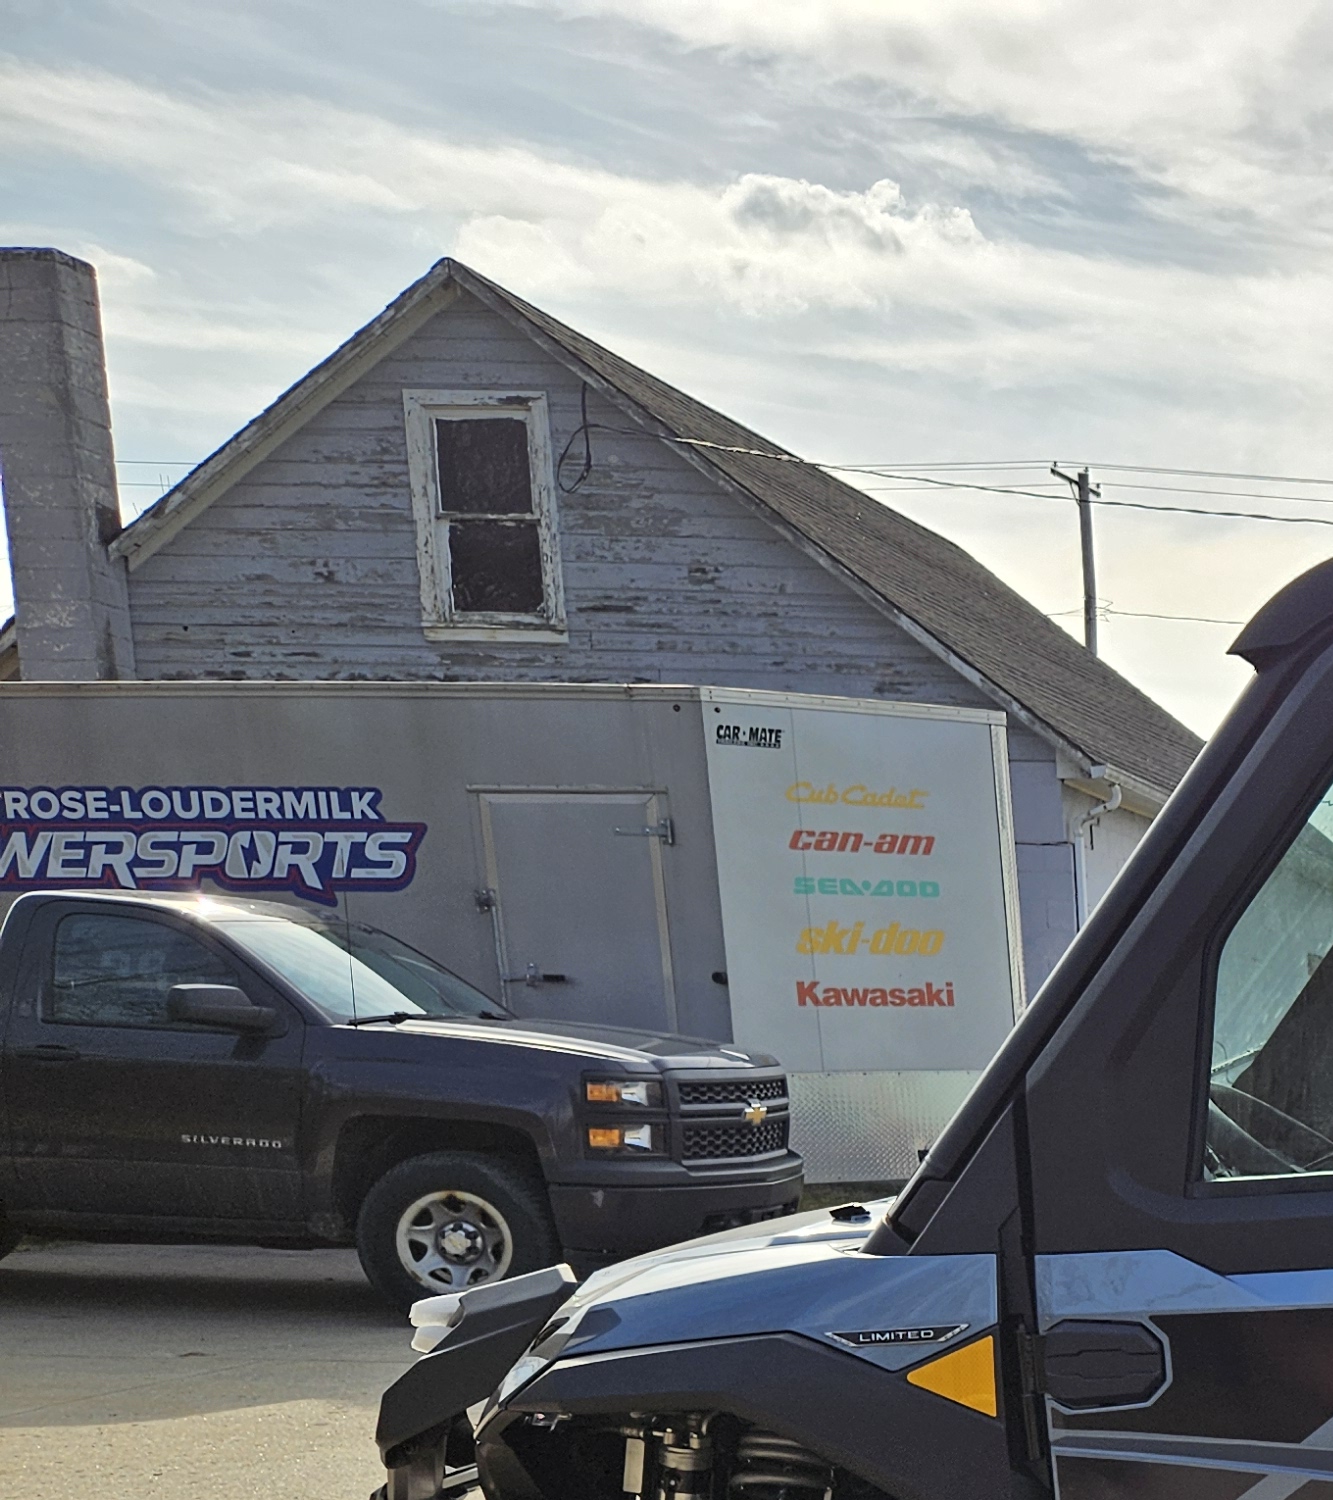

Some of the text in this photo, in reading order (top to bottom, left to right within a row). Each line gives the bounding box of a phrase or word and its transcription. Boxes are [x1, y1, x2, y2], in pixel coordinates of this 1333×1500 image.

[4, 790, 379, 820] ROSE-LOUDERMILK
[785, 781, 838, 804] Cub
[789, 830, 935, 855] can-am
[796, 920, 945, 956] ski-doo
[796, 981, 955, 1007] Kawasaki
[181, 1134, 282, 1149] SILVERADO
[859, 1329, 934, 1342] LIMITED
